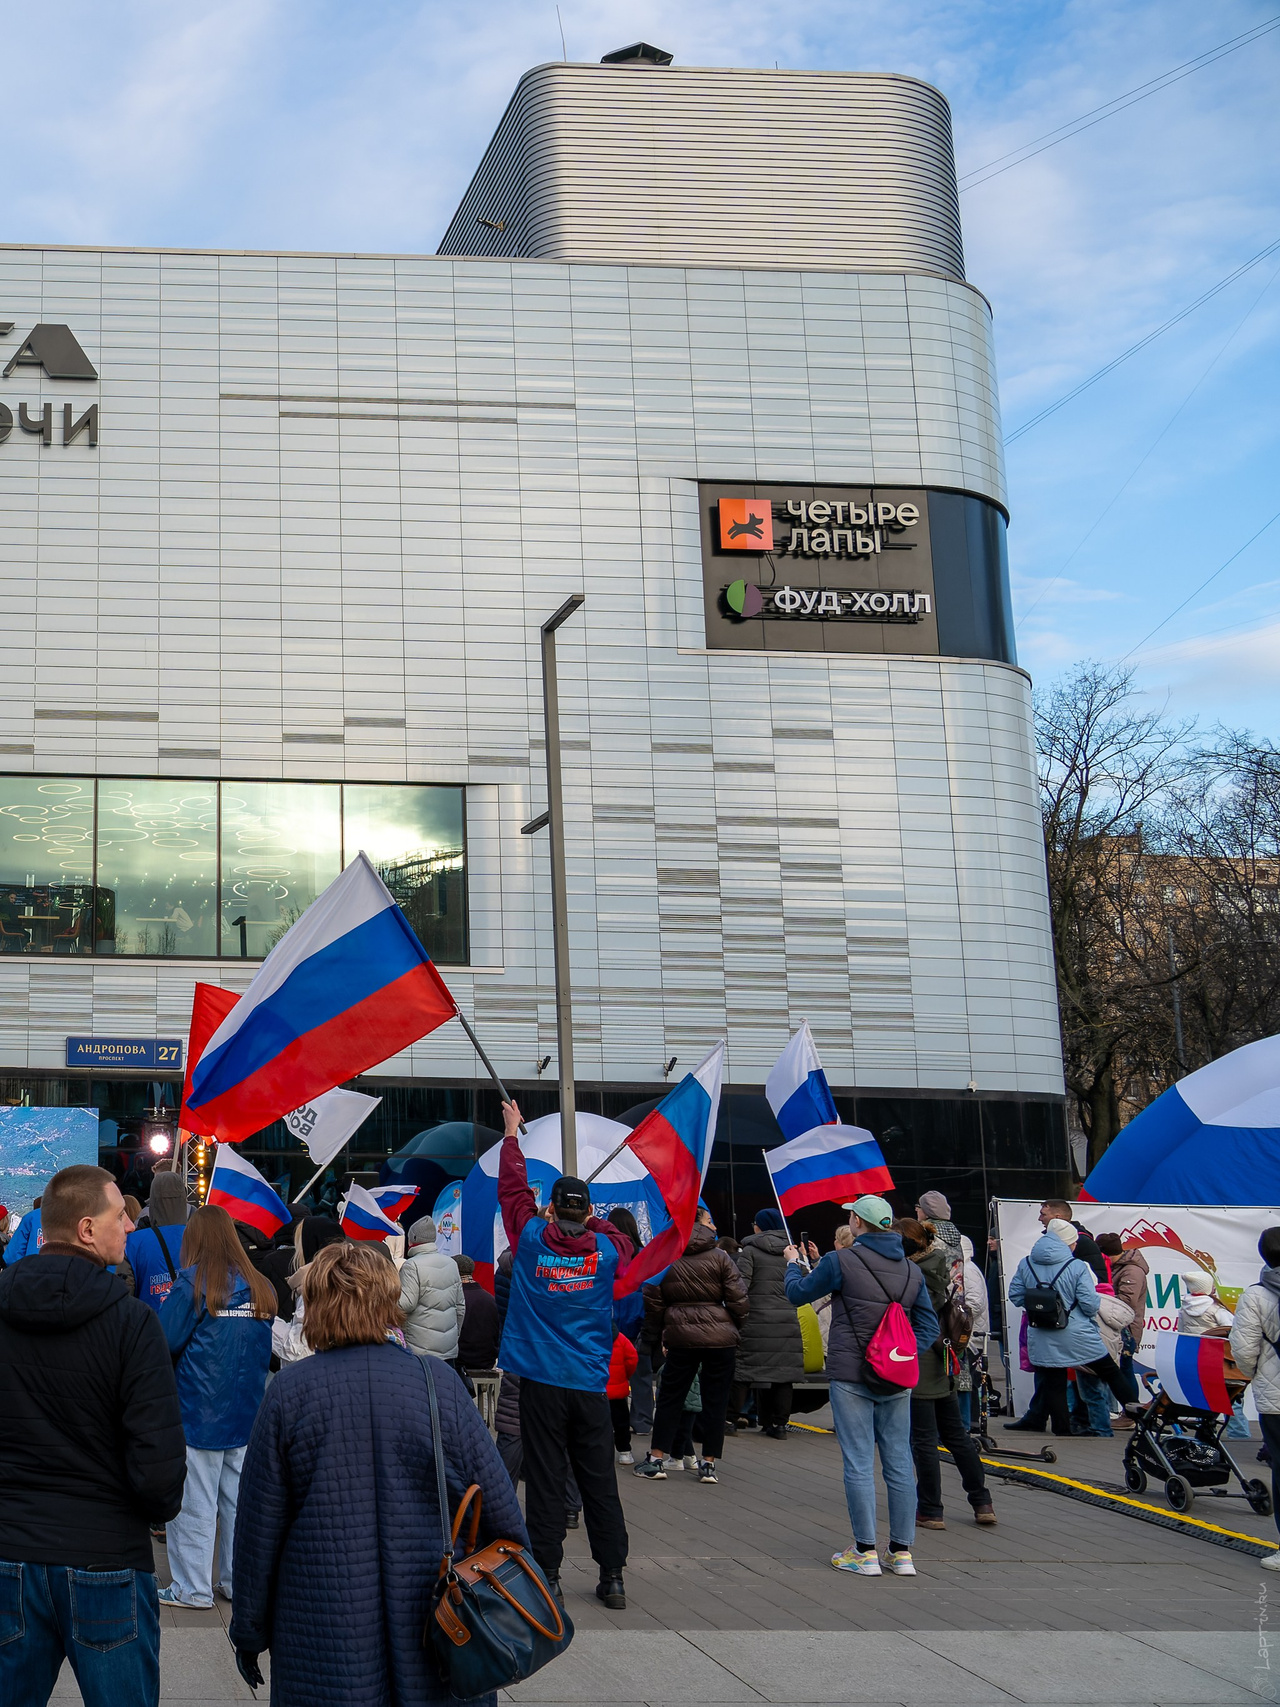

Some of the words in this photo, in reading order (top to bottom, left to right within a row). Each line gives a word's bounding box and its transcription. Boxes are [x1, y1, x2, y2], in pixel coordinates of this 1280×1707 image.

[77, 1044, 146, 1054] АНДРОПОВА
[158, 1046, 179, 1061] 27
[535, 1256, 598, 1279] ГВАРДИЯ
[548, 1280, 594, 1292] МОСКВА
